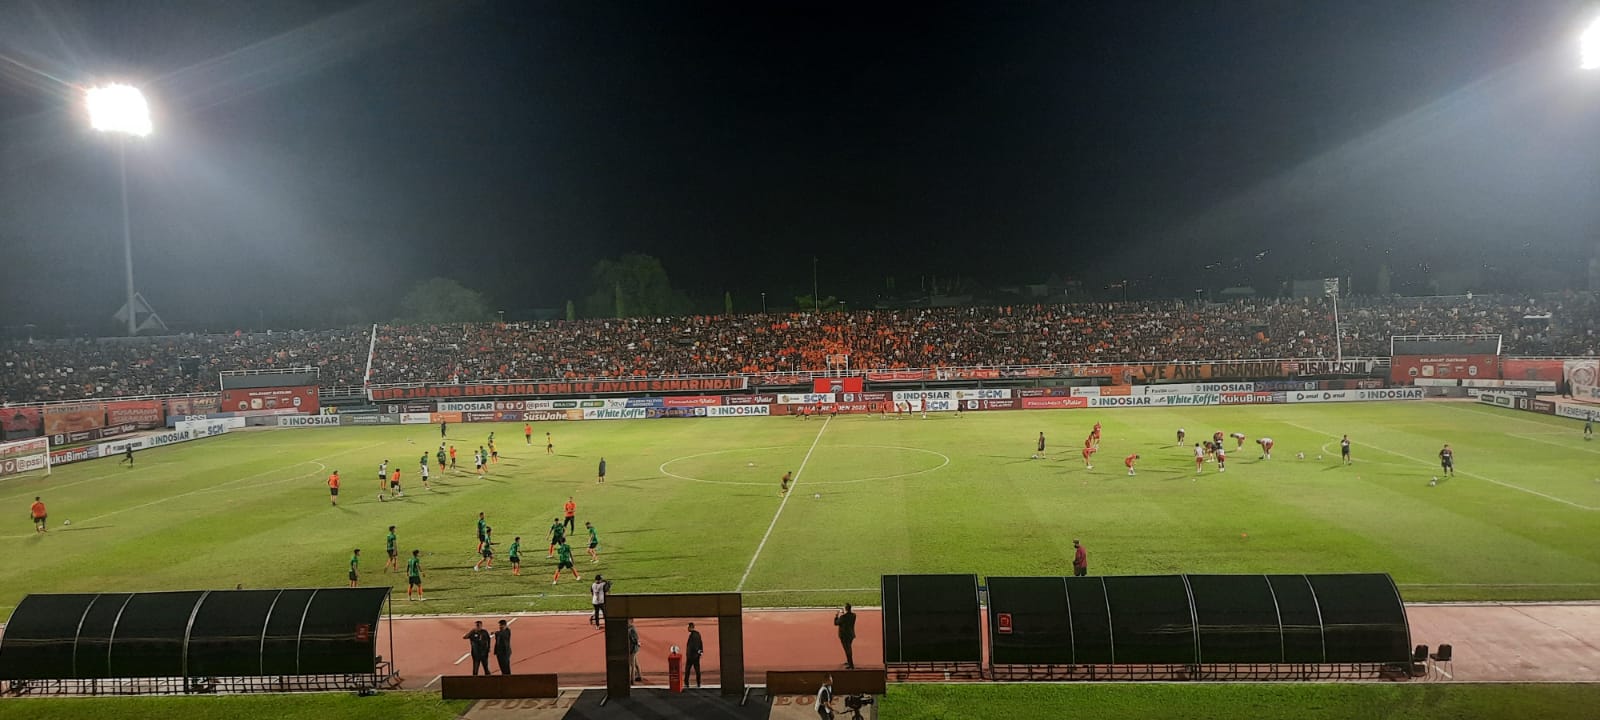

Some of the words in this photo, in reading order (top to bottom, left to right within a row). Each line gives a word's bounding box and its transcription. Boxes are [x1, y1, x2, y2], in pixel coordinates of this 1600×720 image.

[464, 384, 534, 395] BERSAMA
[538, 383, 572, 394] DEMI
[652, 378, 731, 390] SAMARINDA
[1167, 395, 1190, 404] White
[1192, 393, 1218, 405] Koffie
[1220, 394, 1272, 402] KukuBima
[1368, 390, 1422, 399] INDOSIAR
[1100, 397, 1150, 406] INDOSIAR
[596, 409, 620, 418] White
[620, 408, 644, 418] Koffie
[718, 406, 768, 414] INDOSIAR
[290, 416, 338, 425] INDOSIAR
[523, 412, 568, 420] SusuJahe
[208, 424, 224, 435] SCM
[156, 431, 189, 444] INDOSIAR
